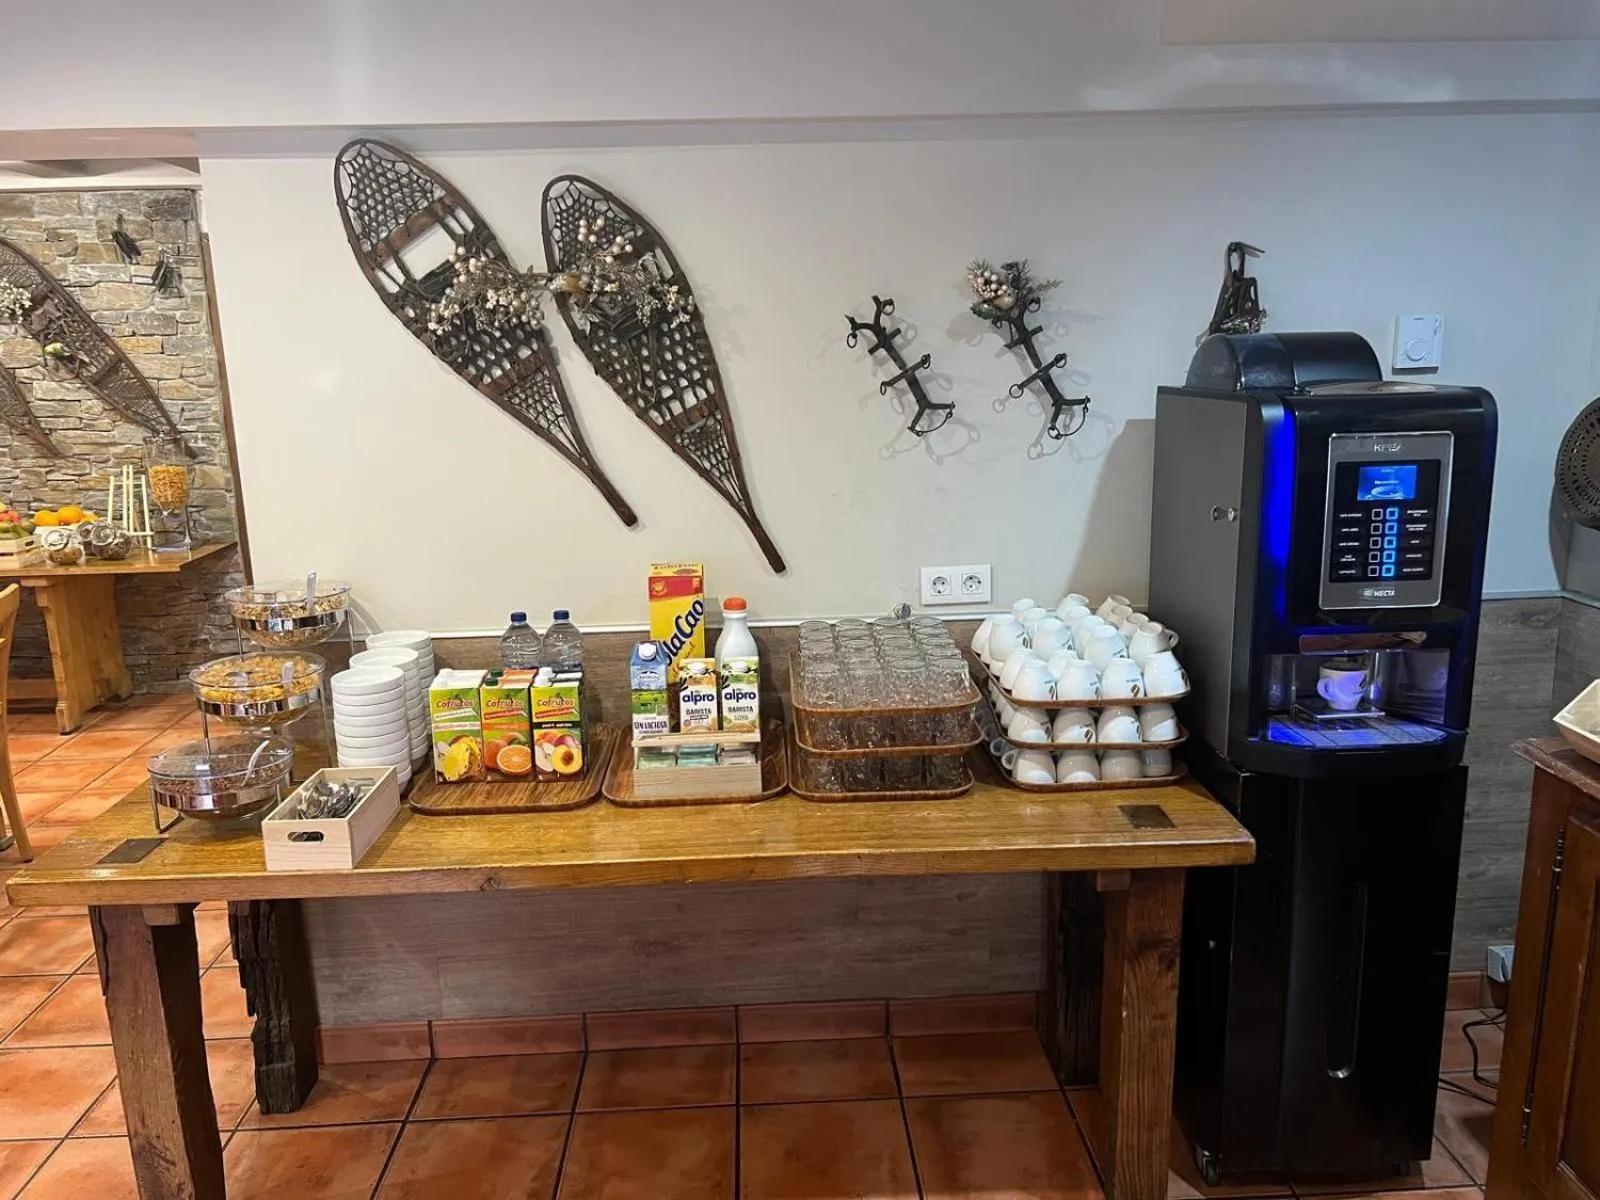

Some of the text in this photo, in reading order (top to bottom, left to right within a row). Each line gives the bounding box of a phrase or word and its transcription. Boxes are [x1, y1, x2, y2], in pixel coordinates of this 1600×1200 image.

[662, 599, 704, 666] laCao
[682, 691, 715, 705] alpro
[724, 688, 756, 703] alpro
[436, 699, 473, 709] Cofrutos
[486, 699, 523, 709] Cofrutos
[537, 698, 574, 708] Cofrutos
